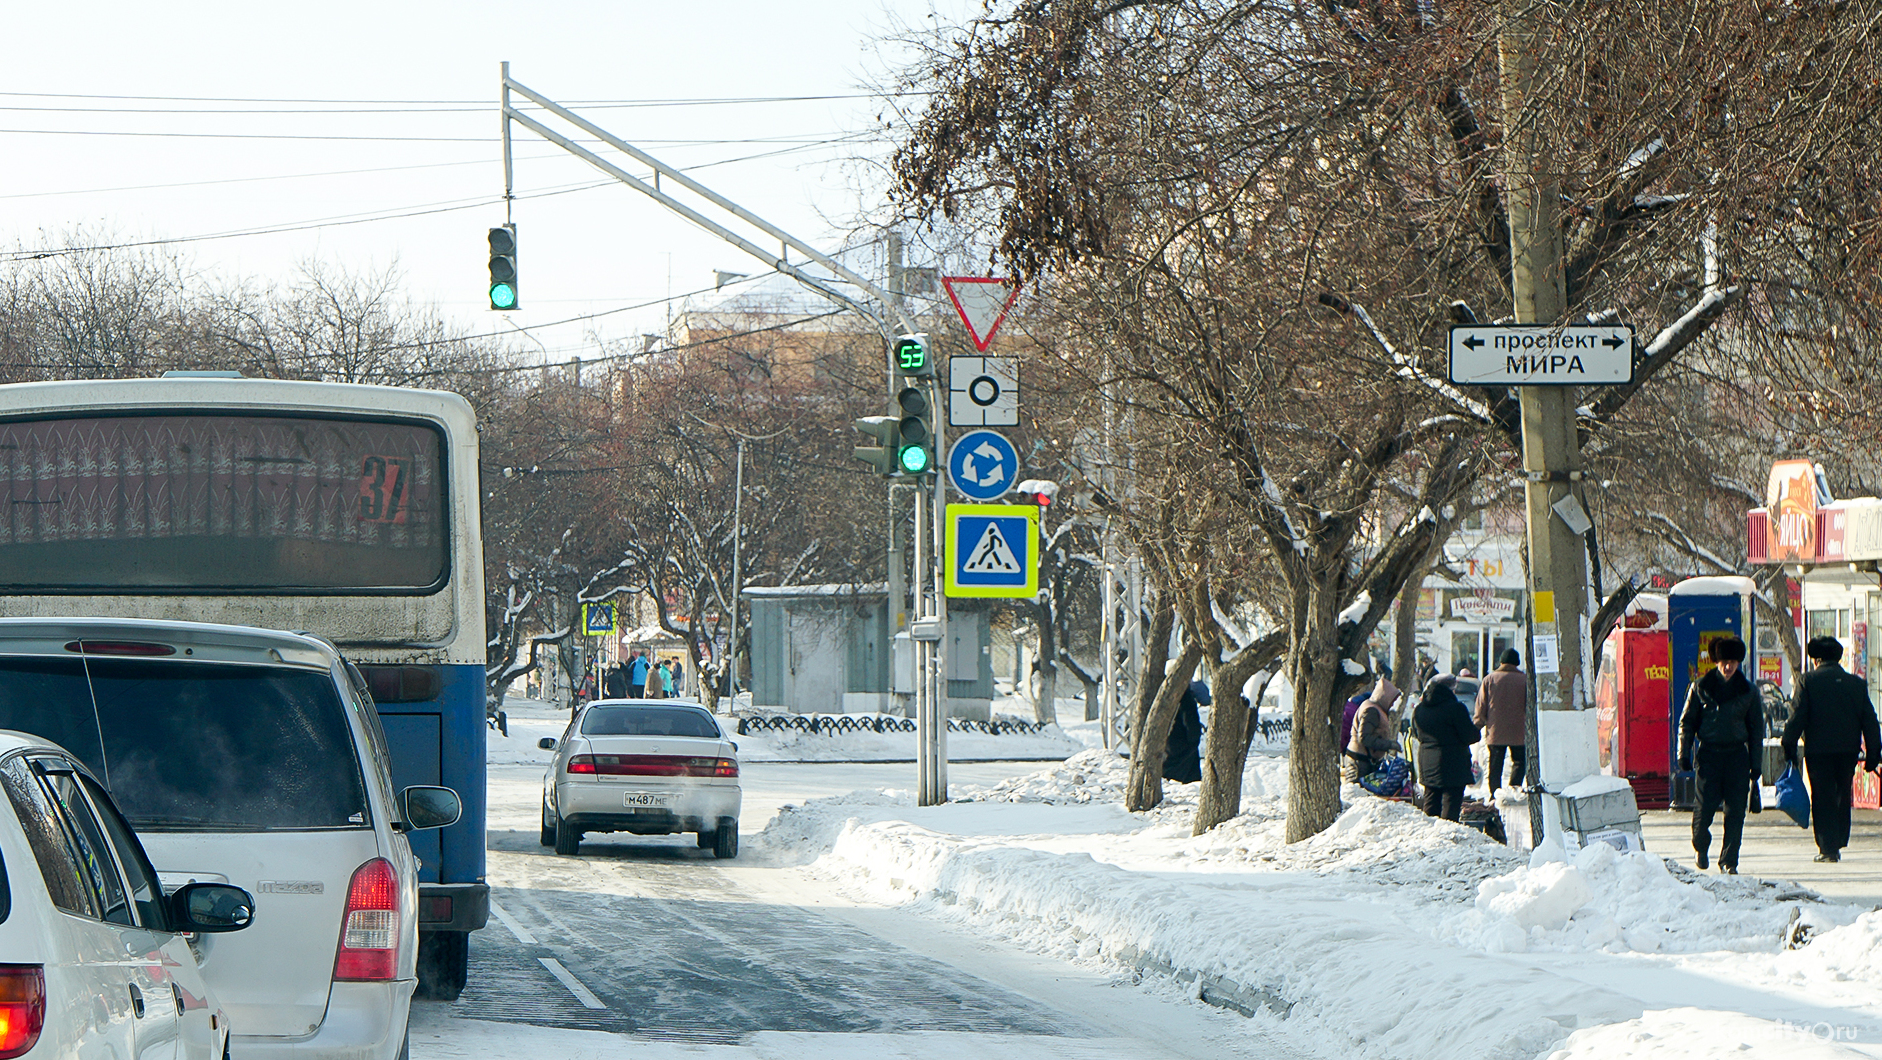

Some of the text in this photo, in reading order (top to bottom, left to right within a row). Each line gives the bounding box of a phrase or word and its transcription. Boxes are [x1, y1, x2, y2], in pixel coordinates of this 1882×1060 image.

[1494, 334, 1598, 352] проспект
[900, 344, 924, 368] 53
[1506, 355, 1585, 374] МИРА
[360, 456, 410, 520] 37
